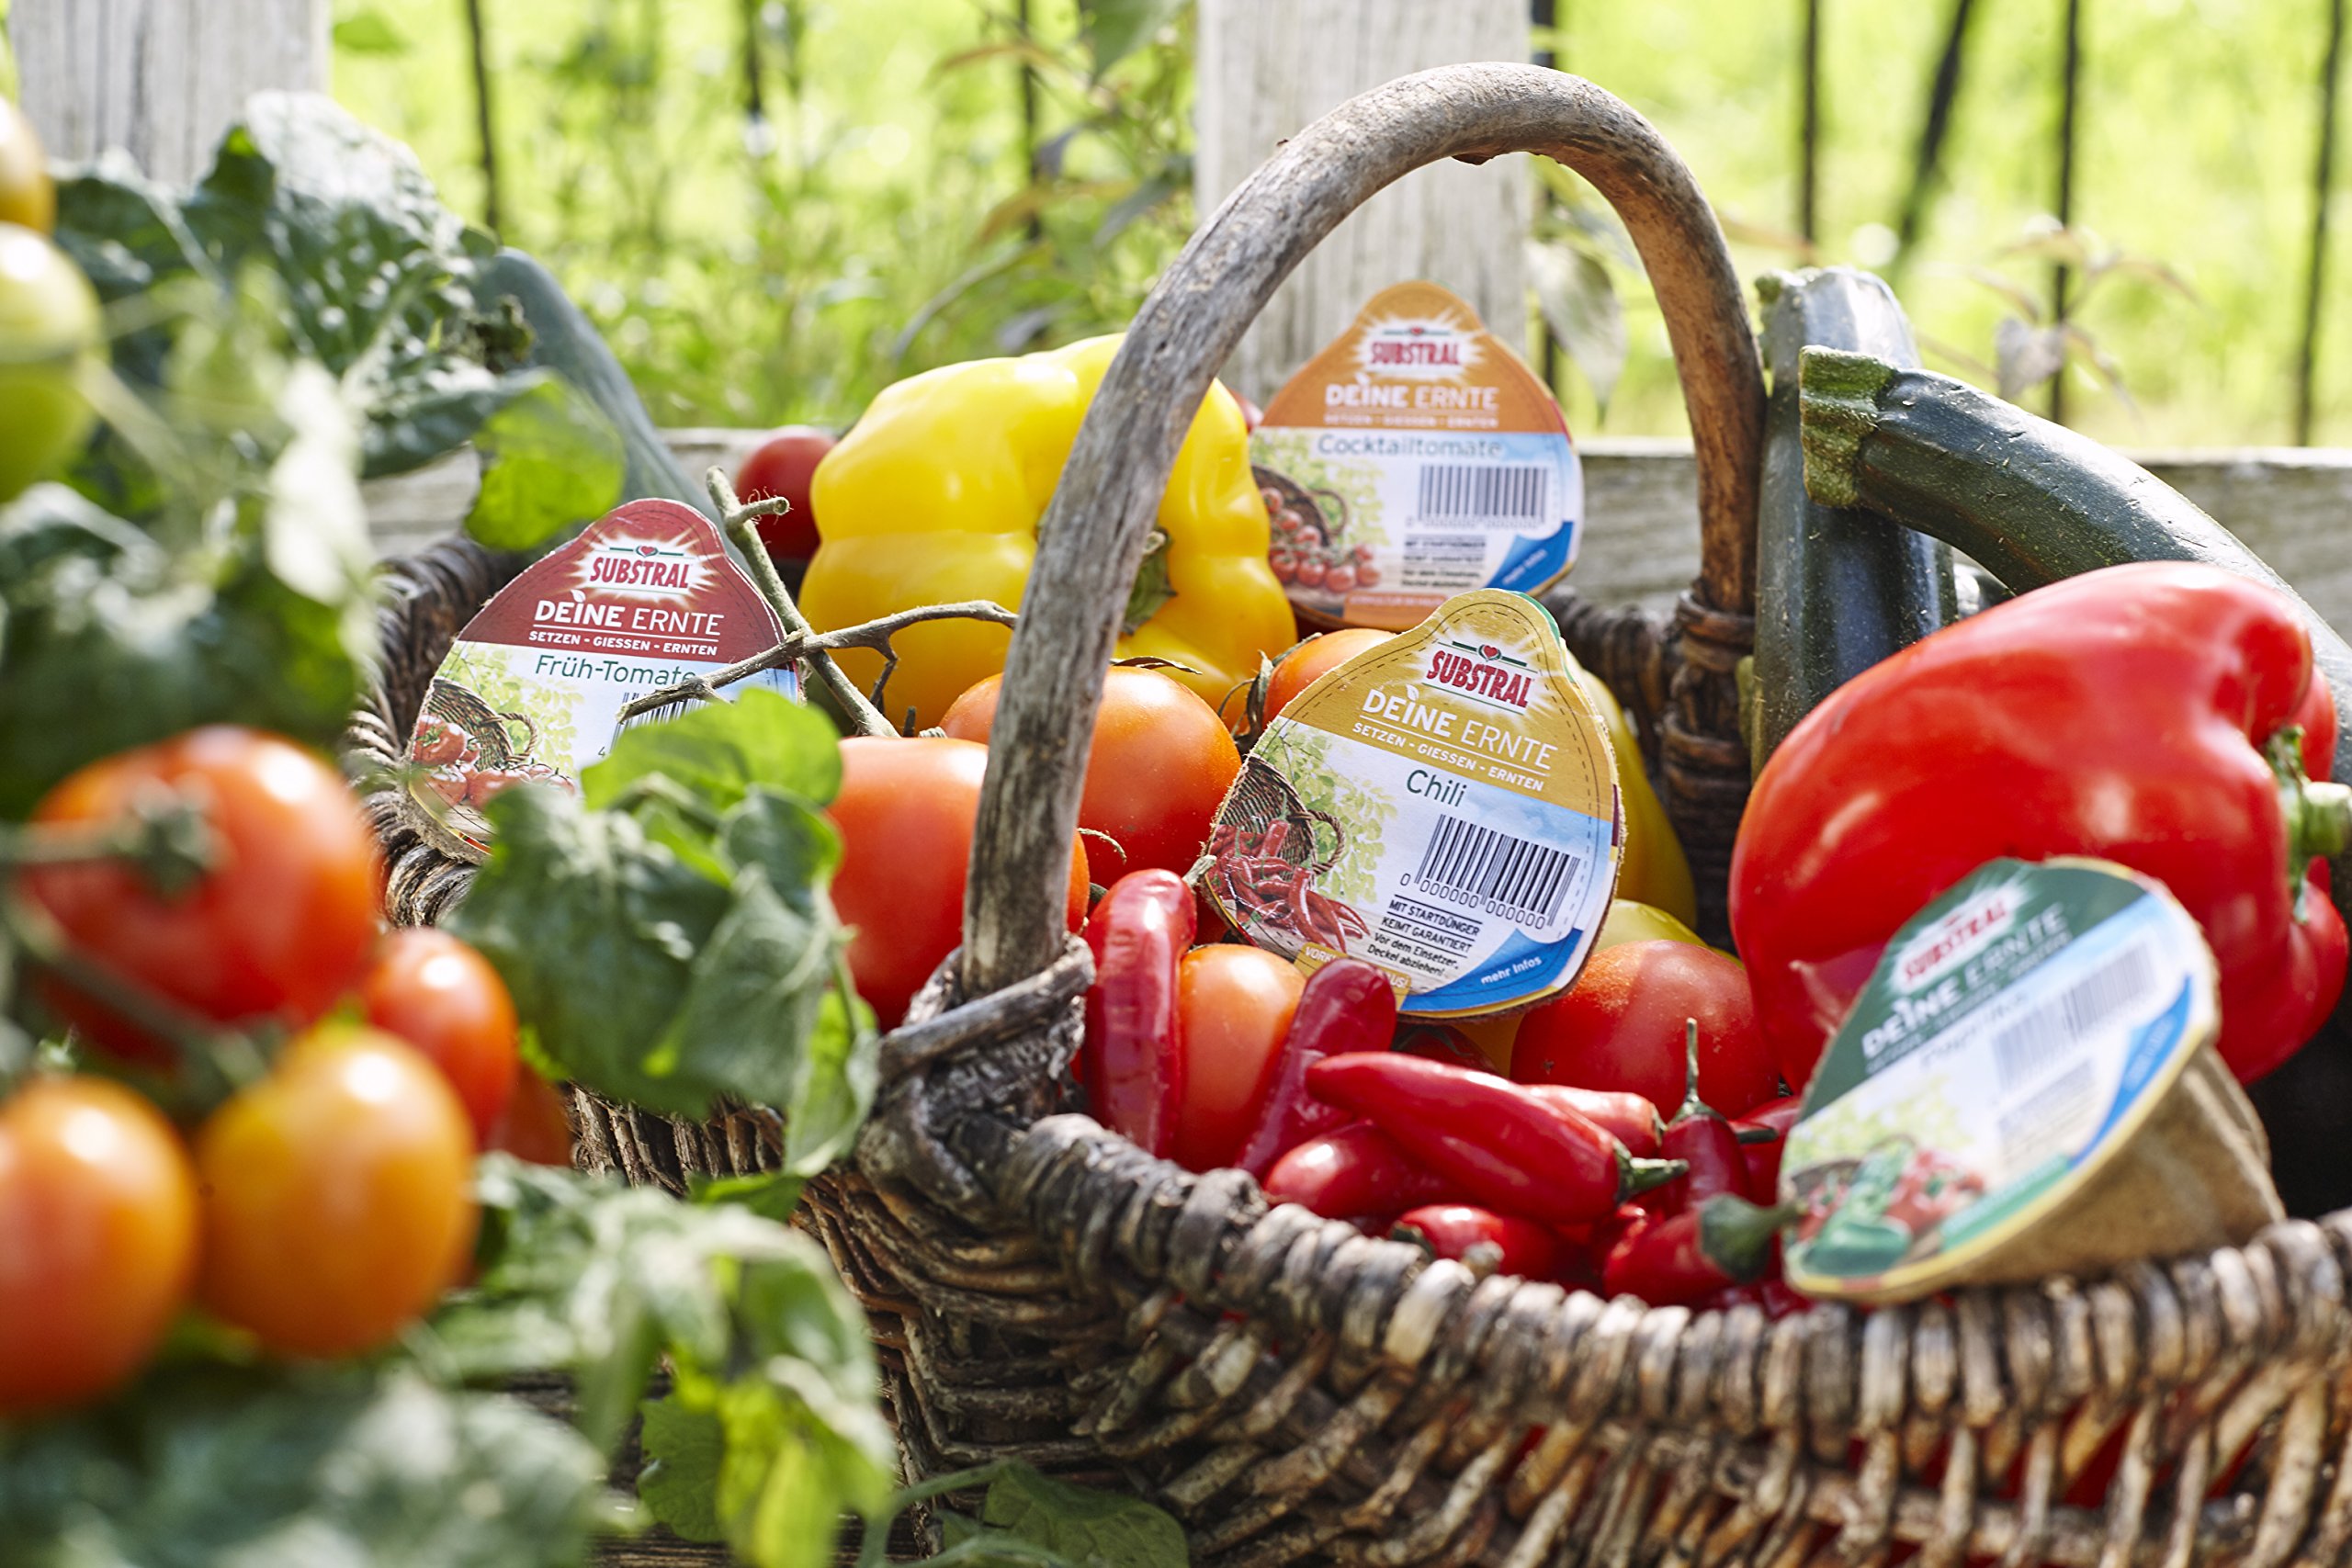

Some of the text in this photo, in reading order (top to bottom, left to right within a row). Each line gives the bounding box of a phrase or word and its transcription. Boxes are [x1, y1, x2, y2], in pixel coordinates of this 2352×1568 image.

[1370, 342, 1461, 365] SUBSTRAL
[1415, 385, 1499, 411] ERNTE
[1318, 434, 1502, 457] Cocktailtomate
[590, 557, 690, 589] SUBSTRAL
[534, 592, 725, 636] DEINE ERNTE
[528, 630, 581, 645] SETZEN
[593, 636, 650, 651] GIESSEN
[662, 642, 718, 656] ERNTEN
[1426, 649, 1532, 708] SUBSTRAL
[1363, 685, 1559, 771] DEINE ERNTE
[1351, 722, 1407, 749] SETZEN
[1418, 743, 1477, 772] GIESSEN
[1487, 766, 1544, 792] ERNTEN
[1407, 769, 1467, 807] Chili
[1388, 898, 1481, 938] MIT STARTDÜNGER
[1374, 932, 1390, 945] Vor
[1390, 938, 1412, 953] dem
[1381, 916, 1473, 953] KEIMT GARANTIERT
[1367, 943, 1399, 962] Deckel
[1480, 955, 1543, 986] mehr Infos
